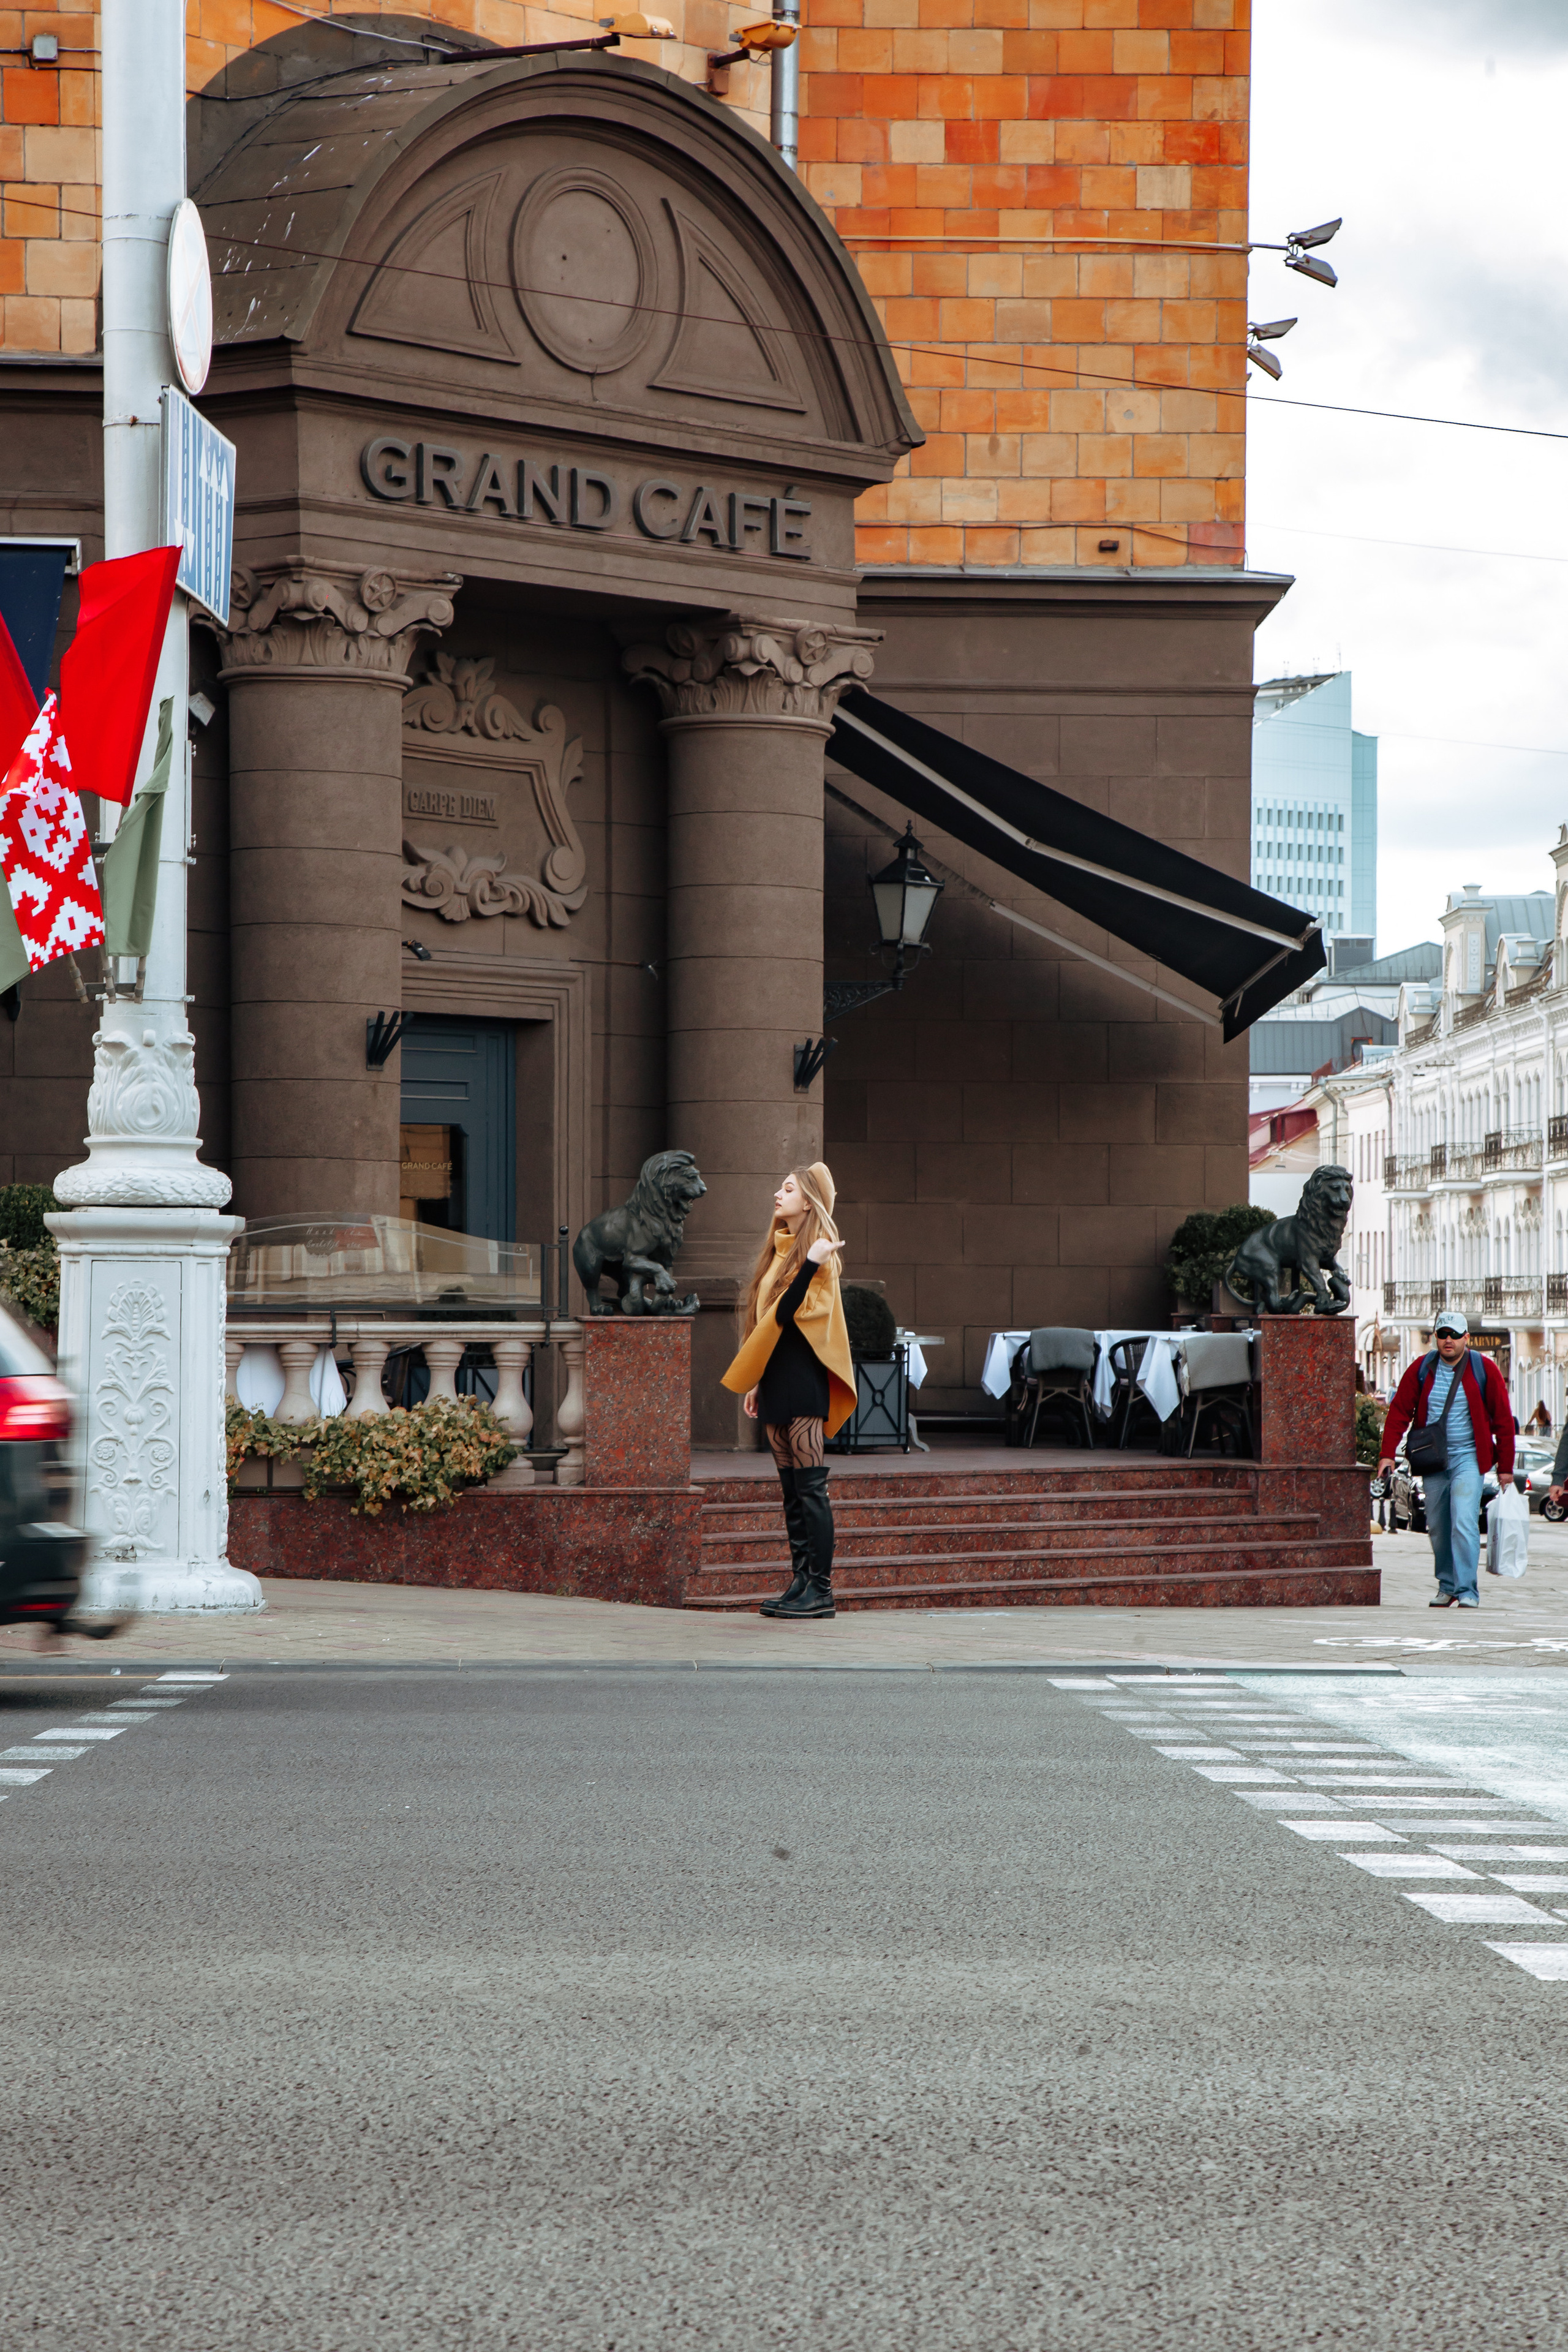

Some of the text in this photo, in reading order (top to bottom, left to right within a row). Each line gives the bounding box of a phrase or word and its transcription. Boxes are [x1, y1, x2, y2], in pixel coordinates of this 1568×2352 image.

[360, 436, 812, 560] GRAND CAFÉ
[407, 790, 496, 821] CARPE DIEM
[431, 1160, 453, 1170] CAFÉ
